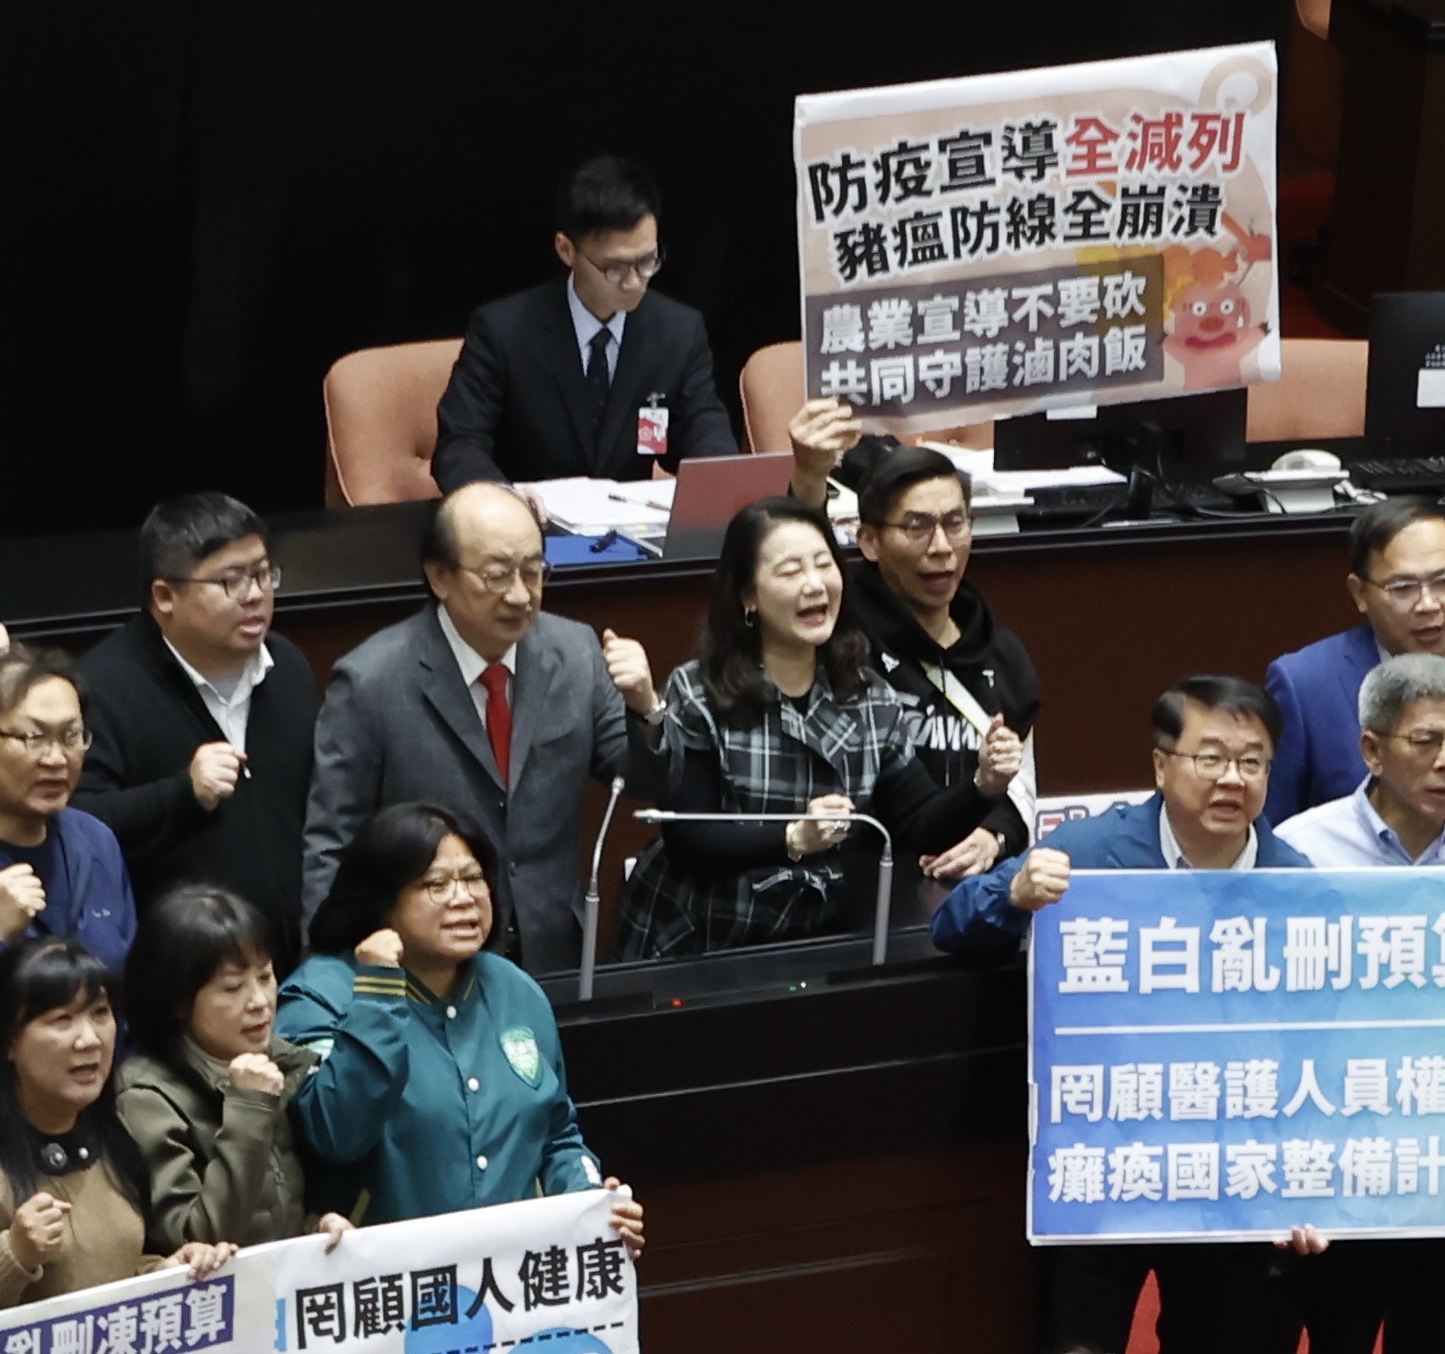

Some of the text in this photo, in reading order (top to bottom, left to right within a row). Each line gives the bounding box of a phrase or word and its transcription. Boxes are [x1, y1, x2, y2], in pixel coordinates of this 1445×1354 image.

[808, 112, 1245, 222] 防疫宣導全減列
[834, 184, 1223, 280] 豬瘟防線全崩潰
[821, 271, 1146, 355] 農業宣導不要砍
[821, 326, 1146, 407] 共同守護滷肉飯
[274, 1236, 626, 1352] 罔顧國人健康
